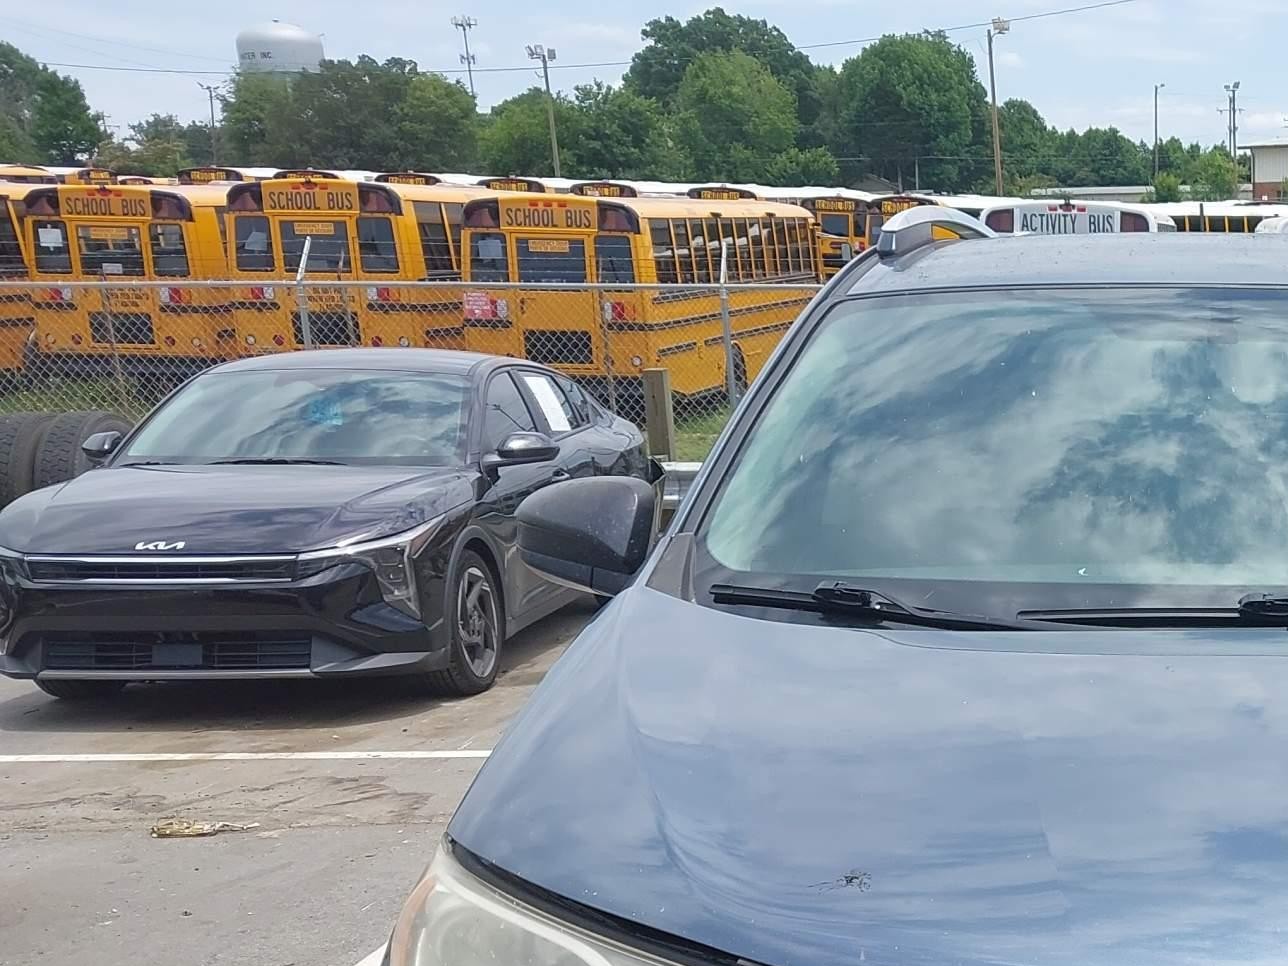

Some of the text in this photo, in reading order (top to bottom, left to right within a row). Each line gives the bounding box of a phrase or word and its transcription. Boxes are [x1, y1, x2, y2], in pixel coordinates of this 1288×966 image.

[66, 198, 146, 216] SCHOOL BUS
[269, 191, 353, 210] SCHOOL BUS
[506, 207, 591, 228] SCHOOL BUS
[1021, 212, 1114, 233] ACTIVITY BUS
[135, 541, 186, 550] KIA
